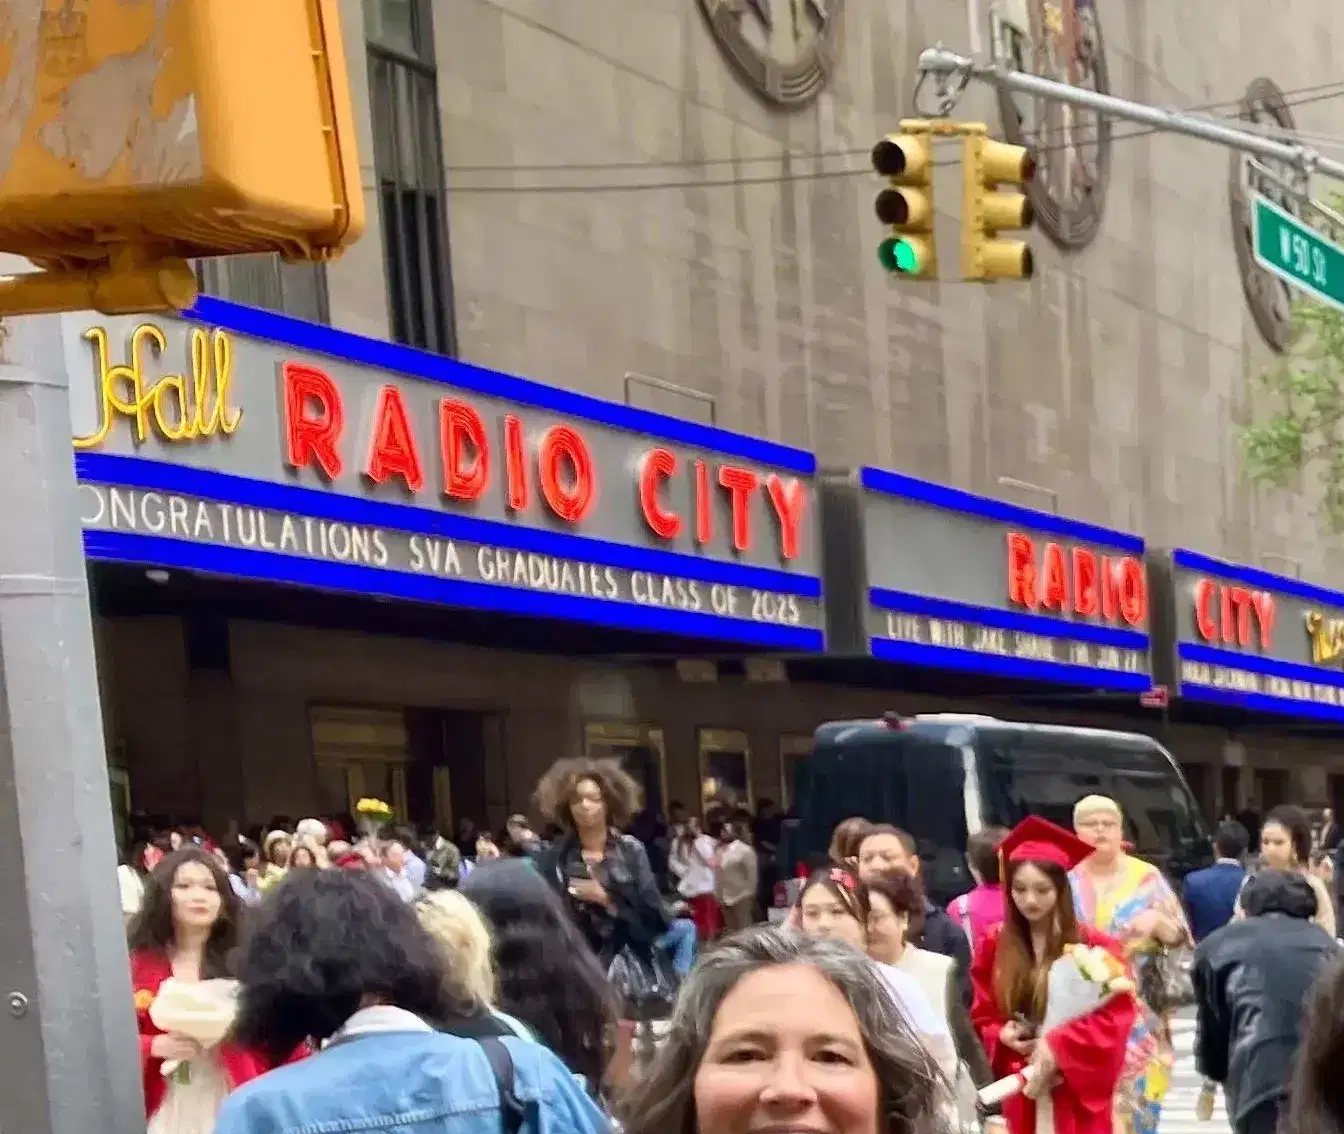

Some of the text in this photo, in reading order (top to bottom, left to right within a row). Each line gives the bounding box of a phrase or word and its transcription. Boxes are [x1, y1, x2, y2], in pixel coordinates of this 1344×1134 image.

[1292, 233, 1311, 276] 50
[72, 323, 243, 447] Hall
[283, 361, 805, 559] RADIO CITY
[78, 484, 801, 624] ONGRATULATIONS SVA GRADUATES CLASS OF 2025
[1008, 531, 1148, 625] RADIO
[1194, 576, 1276, 649] CITY
